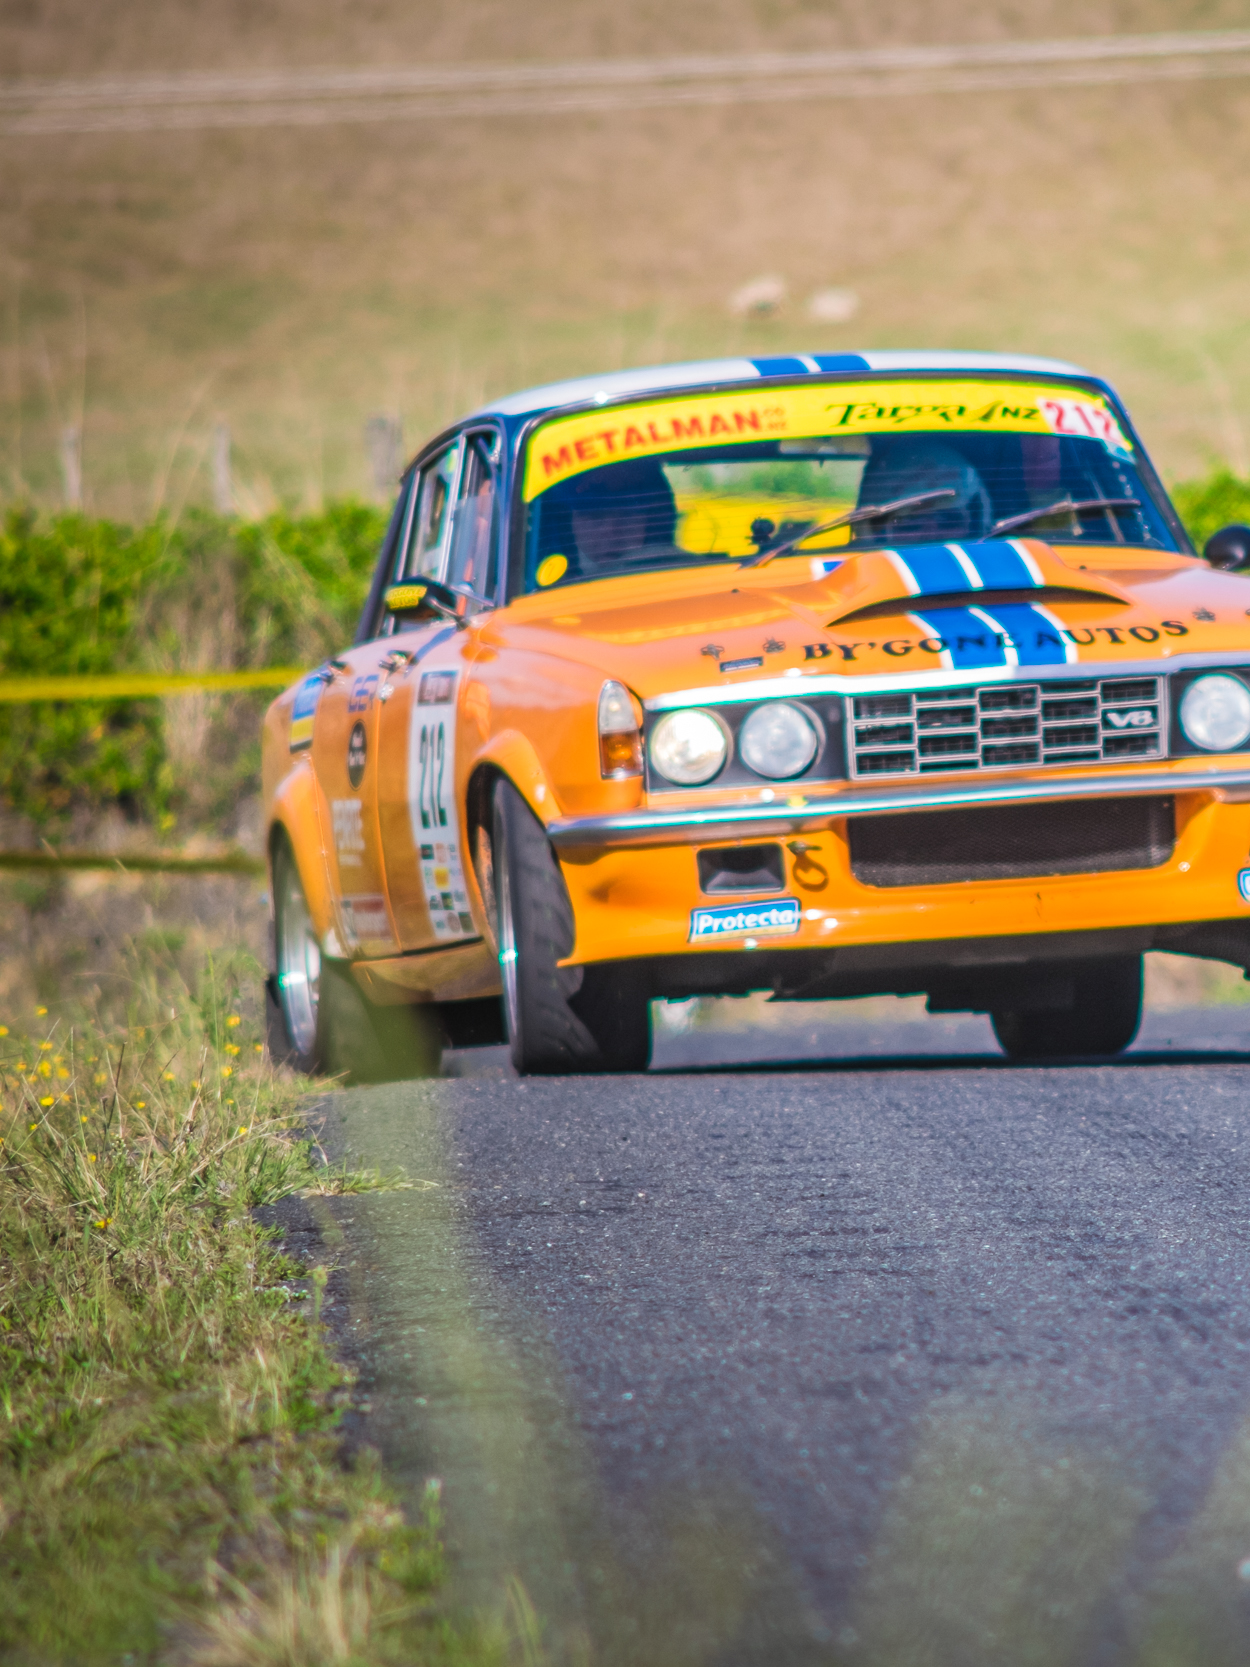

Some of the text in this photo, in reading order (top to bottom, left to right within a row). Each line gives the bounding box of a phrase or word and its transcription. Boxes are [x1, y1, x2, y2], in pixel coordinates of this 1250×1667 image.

[1001, 406, 1039, 420] NZ
[1045, 401, 1122, 445] 212
[541, 409, 761, 478] METALMAN
[802, 620, 1190, 662] BY'GONE AUTOS
[1107, 710, 1153, 727] V8
[419, 720, 448, 829] 212
[698, 908, 794, 933] Protecta
